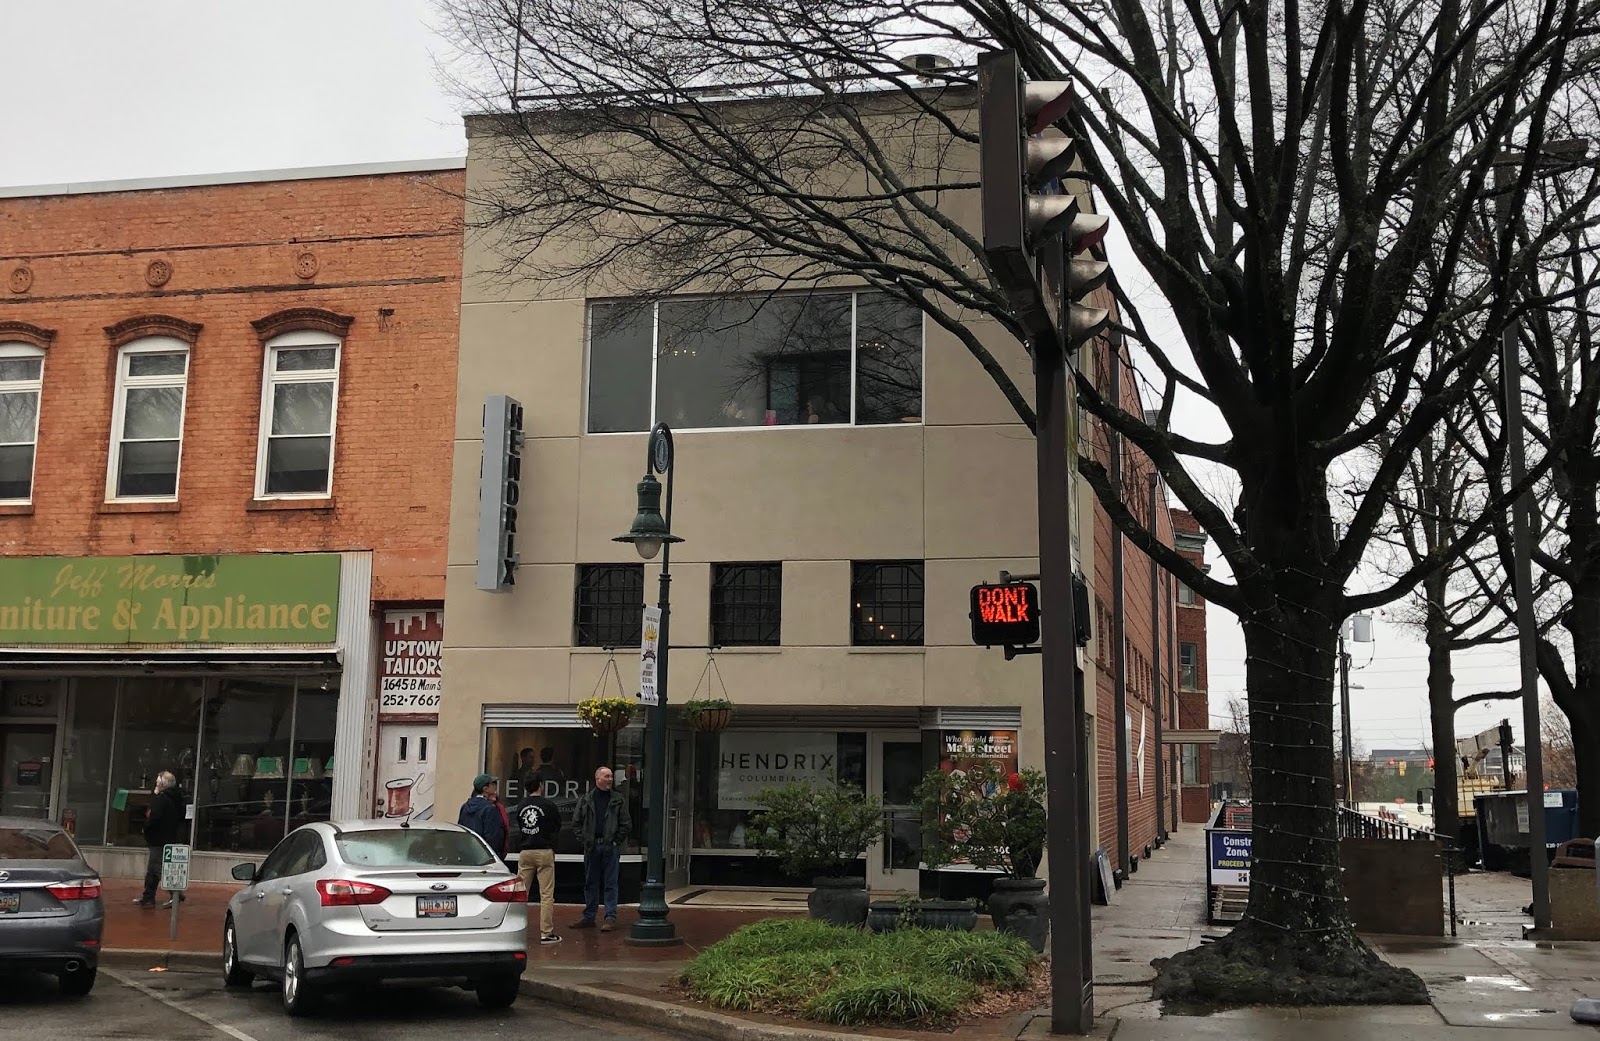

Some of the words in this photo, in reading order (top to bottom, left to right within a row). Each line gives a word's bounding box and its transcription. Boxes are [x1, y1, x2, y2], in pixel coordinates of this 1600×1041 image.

[502, 403, 524, 586] HENDRIX
[50, 563, 109, 598] Jeff
[0, 596, 101, 630] niture
[112, 598, 142, 631] &
[151, 595, 331, 640] Appliance
[980, 604, 1030, 622] WALK
[383, 678, 409, 690] 1645
[410, 679, 417, 690] B
[417, 679, 436, 690] Main
[721, 752, 834, 771] HENDRIX
[739, 774, 797, 783] COLUMBIA
[1223, 836, 1252, 847] Constr
[165, 848, 172, 860] 2
[1218, 860, 1244, 868] PROCEED
